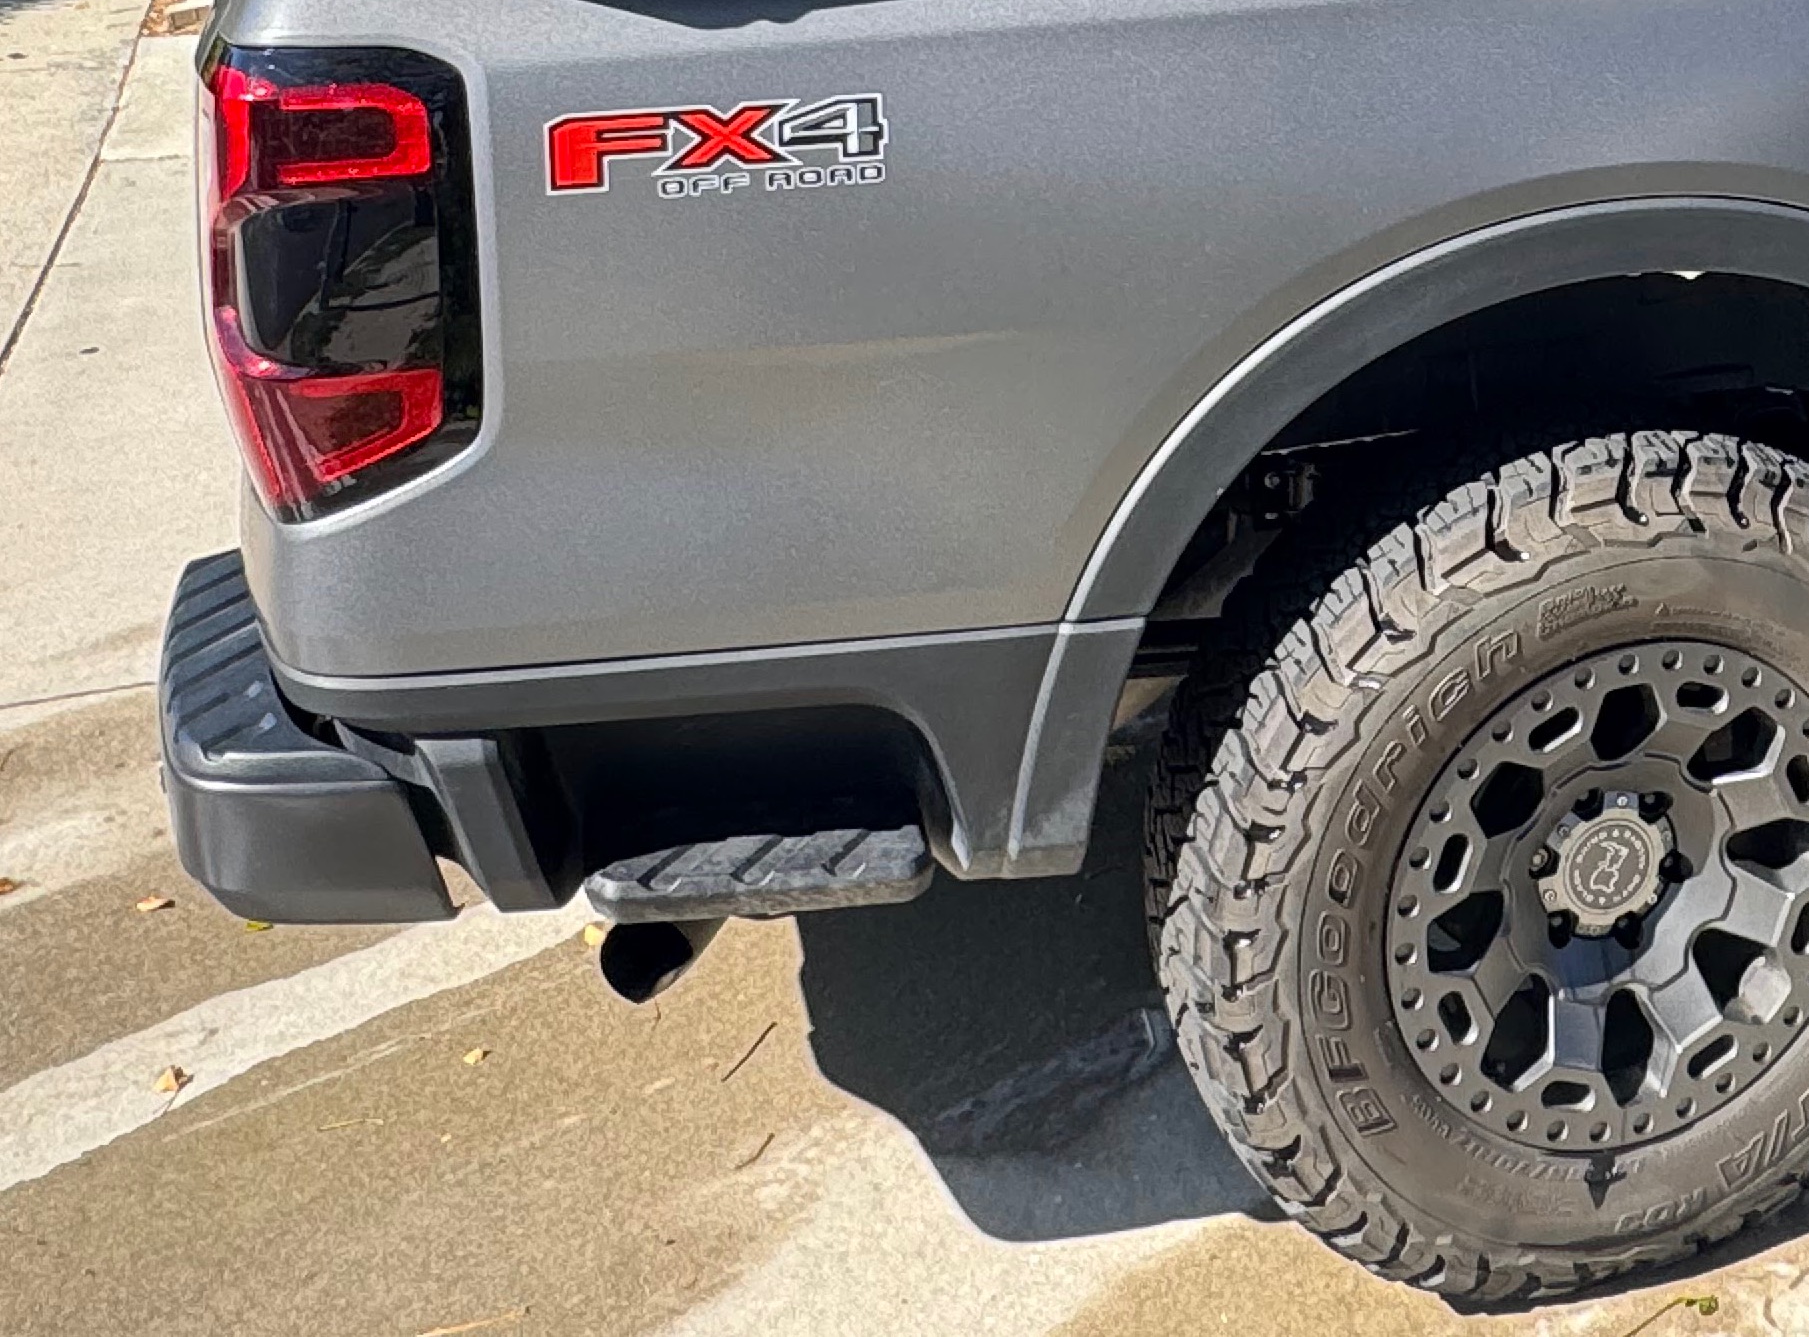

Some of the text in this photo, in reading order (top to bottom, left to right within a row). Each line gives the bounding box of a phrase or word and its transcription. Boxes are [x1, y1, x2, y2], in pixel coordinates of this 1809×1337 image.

[544, 93, 888, 196] FX4
[658, 162, 886, 199] OFF ROAD
[1308, 628, 1522, 1137] BFGoodrich
